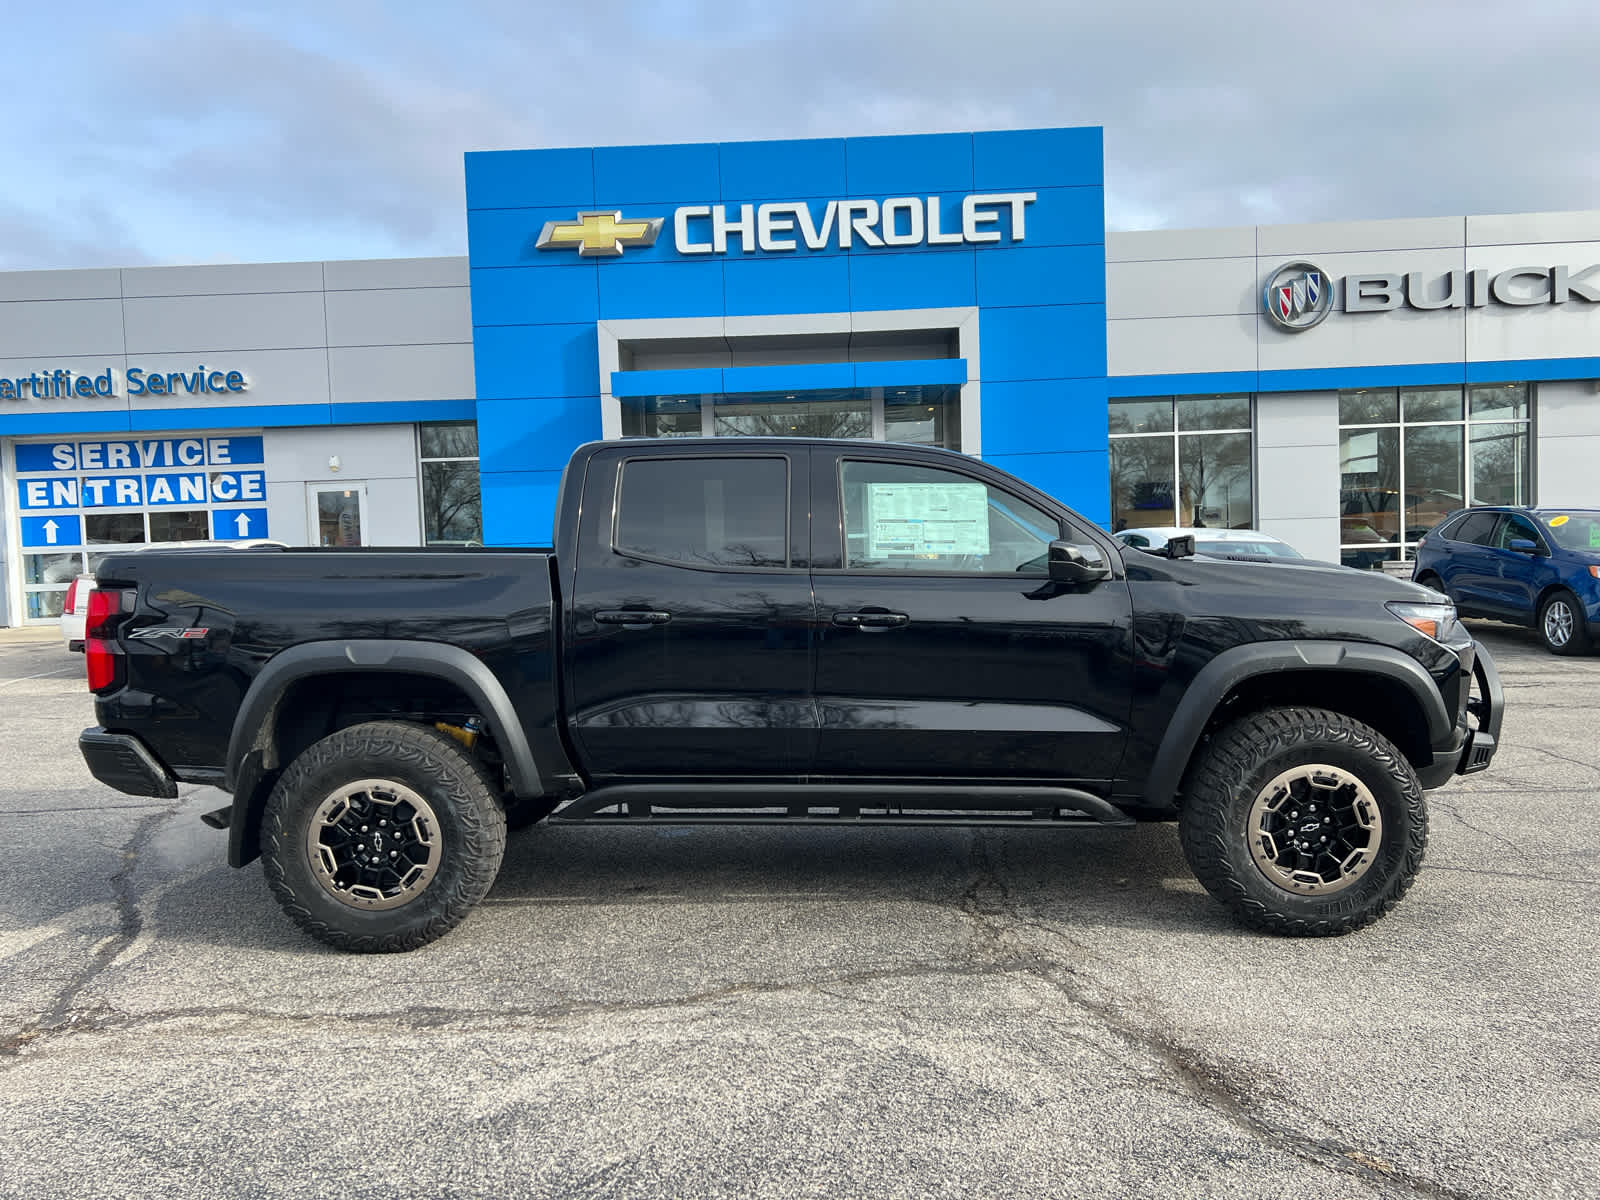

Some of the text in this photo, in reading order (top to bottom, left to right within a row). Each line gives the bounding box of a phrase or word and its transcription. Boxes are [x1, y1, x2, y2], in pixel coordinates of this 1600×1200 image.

[673, 191, 1037, 254] CHEVROLET
[1343, 264, 1600, 313] BUICK
[126, 364, 246, 395] Service
[52, 438, 232, 470] SERVICE
[26, 473, 263, 507] ENTRANCE
[127, 627, 209, 640] ZR2
